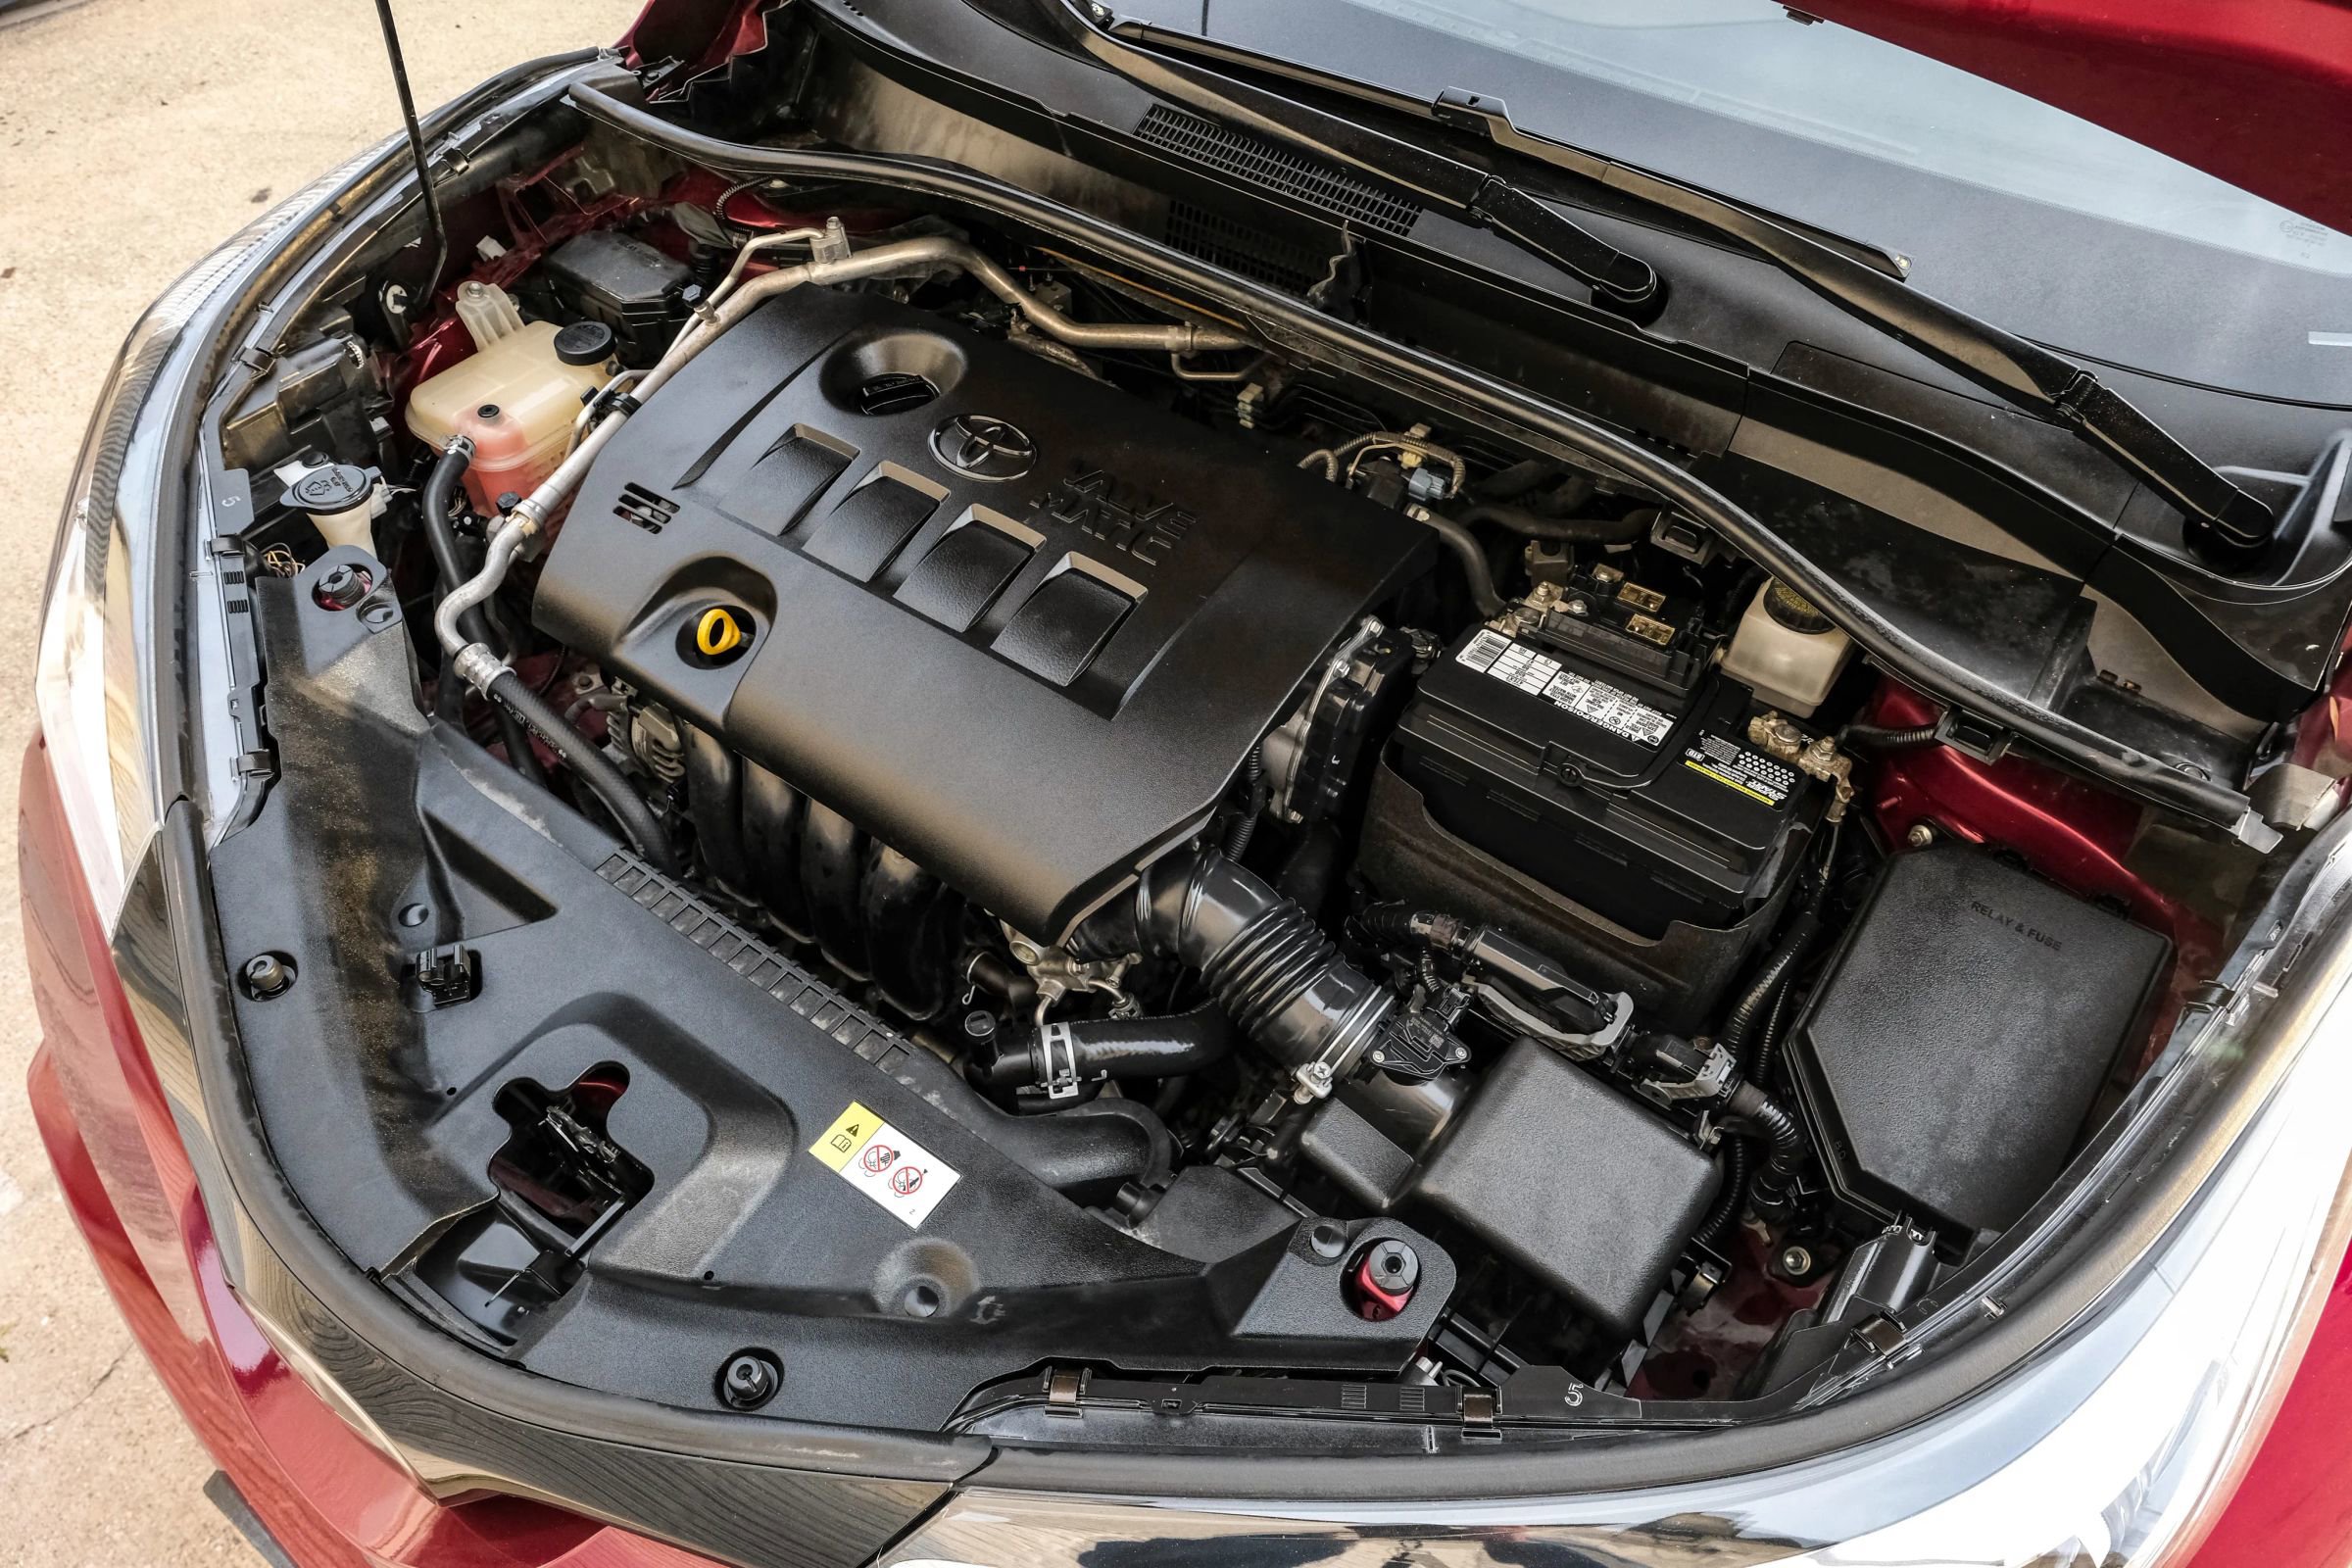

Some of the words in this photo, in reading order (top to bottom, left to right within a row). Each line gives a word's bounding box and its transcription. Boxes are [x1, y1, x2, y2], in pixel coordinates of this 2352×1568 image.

[1553, 700, 1629, 737] DANGER/POISON
[1971, 902, 2014, 927] RELAY
[2014, 922, 2024, 934] &
[2028, 928, 2063, 951] FUSE
[1564, 1383, 1584, 1407] 5
